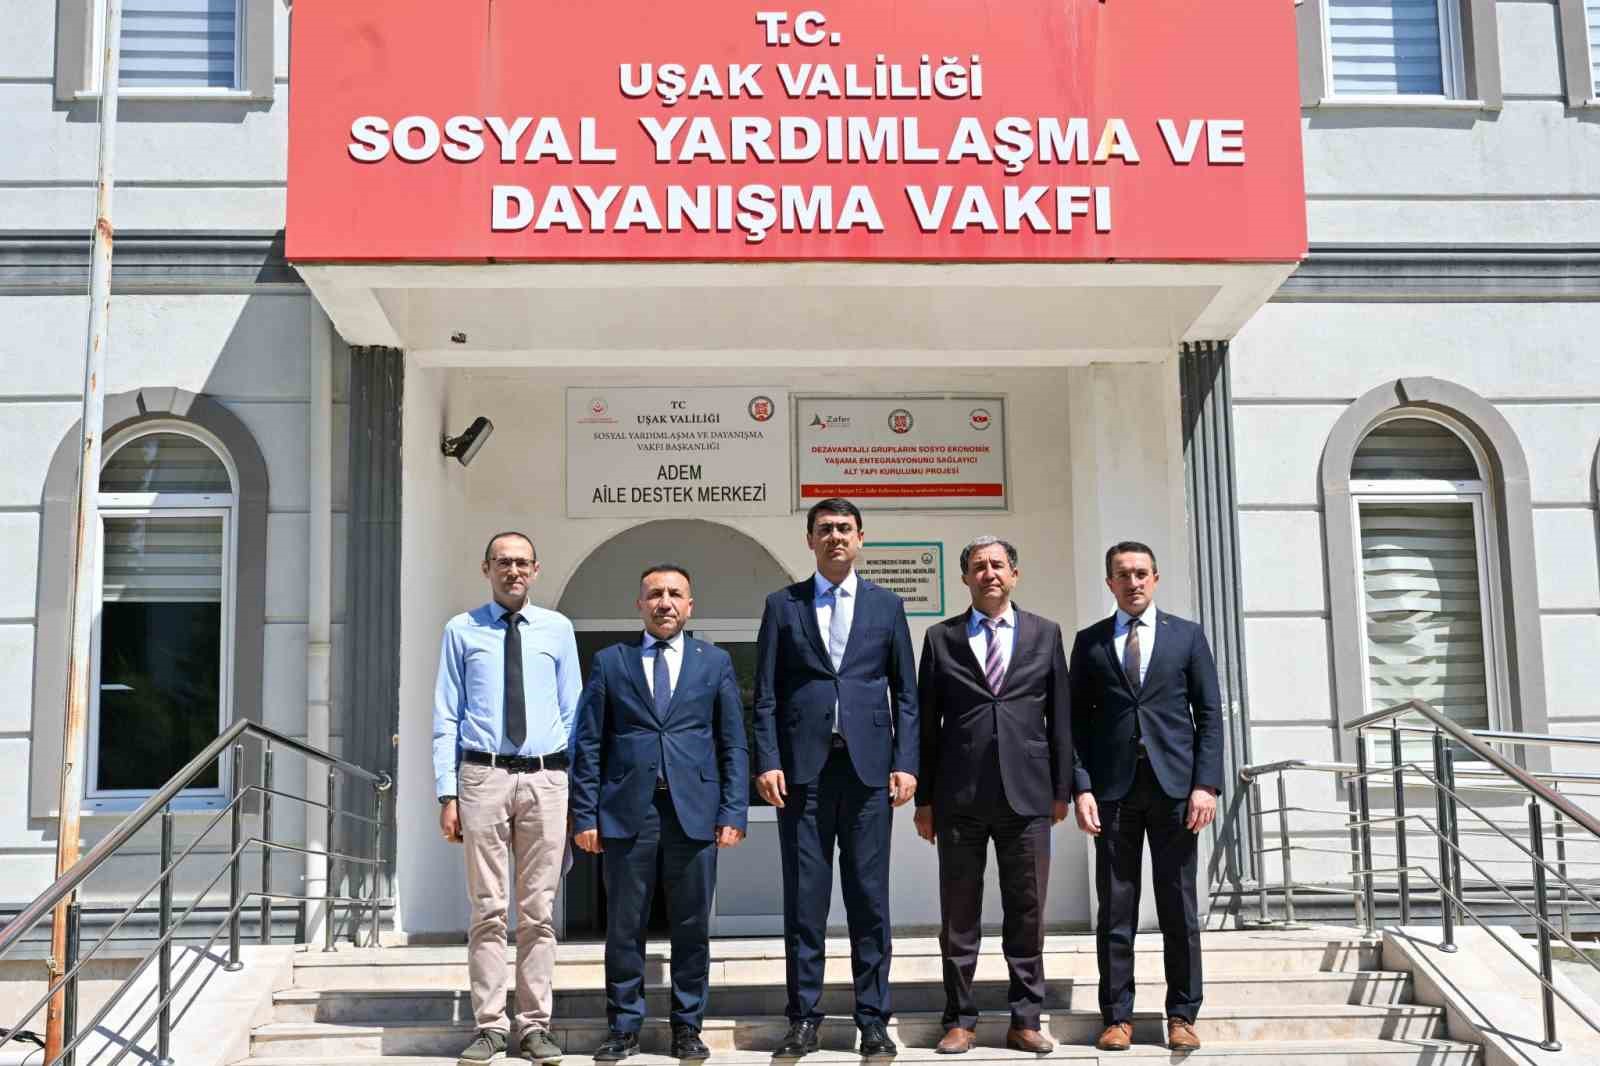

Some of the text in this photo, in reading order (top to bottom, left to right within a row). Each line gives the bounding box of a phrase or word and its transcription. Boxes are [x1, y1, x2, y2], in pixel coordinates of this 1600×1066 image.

[756, 11, 841, 46] T.C.
[619, 54, 983, 105] UŞAK VALİLİĞİ
[348, 115, 1245, 174] SOSYAL YARDIMLAŞMA VE
[491, 184, 1112, 243] DAYANIŞMA VAKFI
[670, 400, 687, 409] TC
[637, 413, 720, 425] UŞAK VALİLİĞİ
[593, 431, 764, 441] SOSYAL YARDIMLAŞMA VE DAYANIŞMA
[637, 441, 720, 452] VAKFI BAŞKANLIĞI
[947, 445, 990, 453] EKONOMİK
[824, 457, 857, 466] YAŞAMA
[936, 455, 978, 464] SAĞLAYICI
[657, 464, 702, 480] ADEM
[880, 467, 923, 475] KURULUMU
[926, 466, 960, 475] PROJESİ
[592, 483, 767, 503] AİLE DESTEK MERKEZİ
